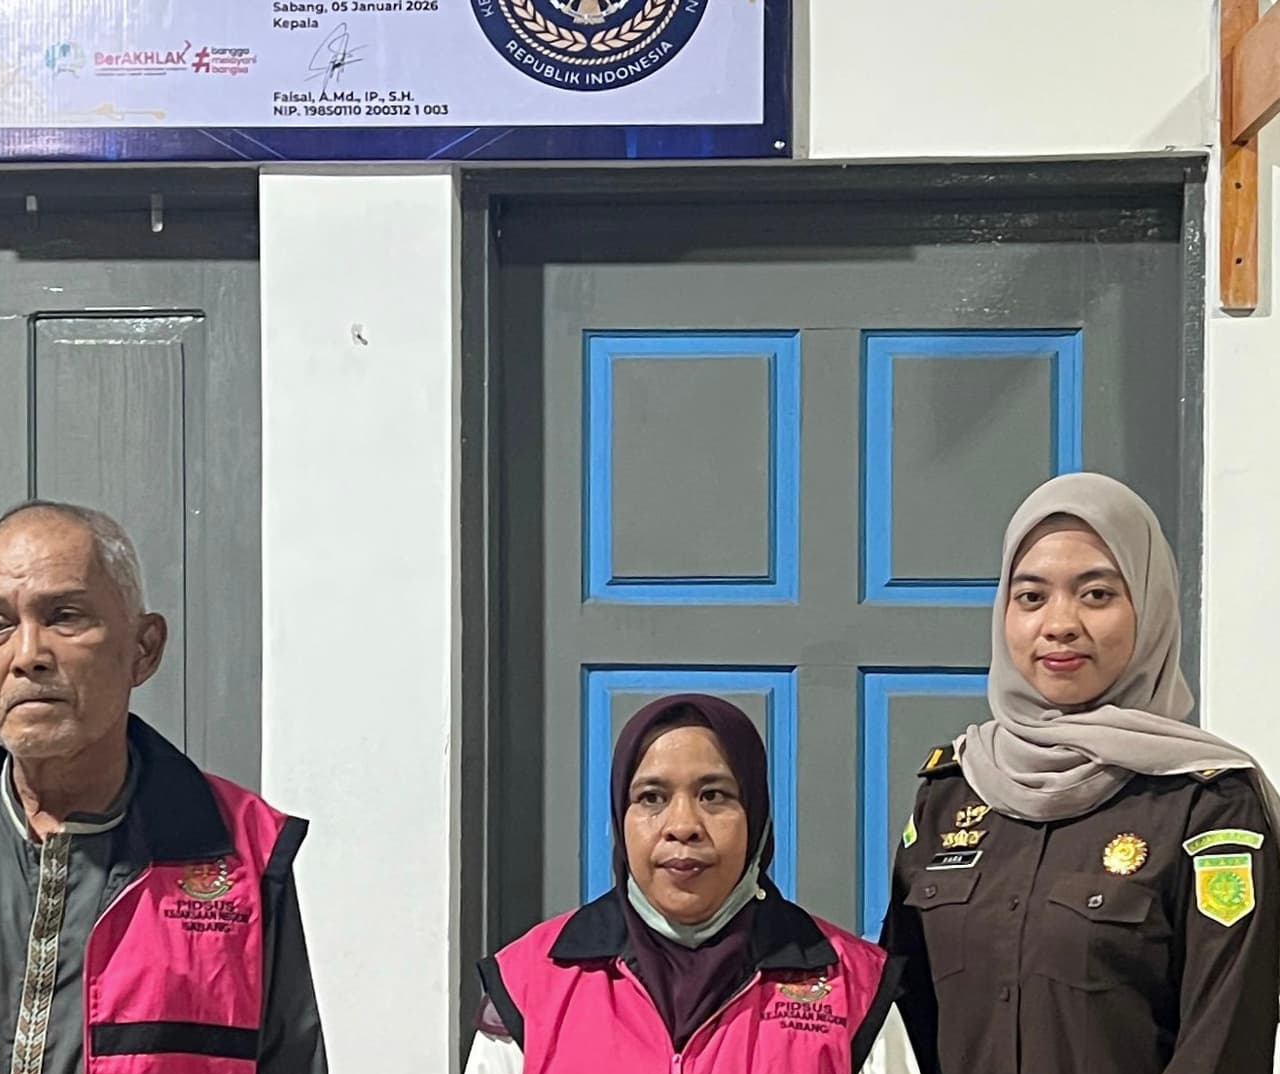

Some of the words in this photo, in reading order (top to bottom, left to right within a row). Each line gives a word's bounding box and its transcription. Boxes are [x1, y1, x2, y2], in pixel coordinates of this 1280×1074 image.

[273, 2, 328, 14] Sabang,
[332, 2, 349, 12] 05
[352, 1, 413, 12] Januari
[416, 1, 438, 12] 2026
[273, 17, 319, 31] Kepala
[506, 40, 580, 84] REPUBLIK
[586, 41, 673, 84] INDONESIA
[273, 91, 313, 104] Faisal,
[273, 105, 301, 116] NIP.
[365, 105, 411, 116] 200312
[423, 105, 449, 116] 003
[775, 1001, 833, 1016] PIDSUS
[780, 1021, 829, 1034] SABANG
